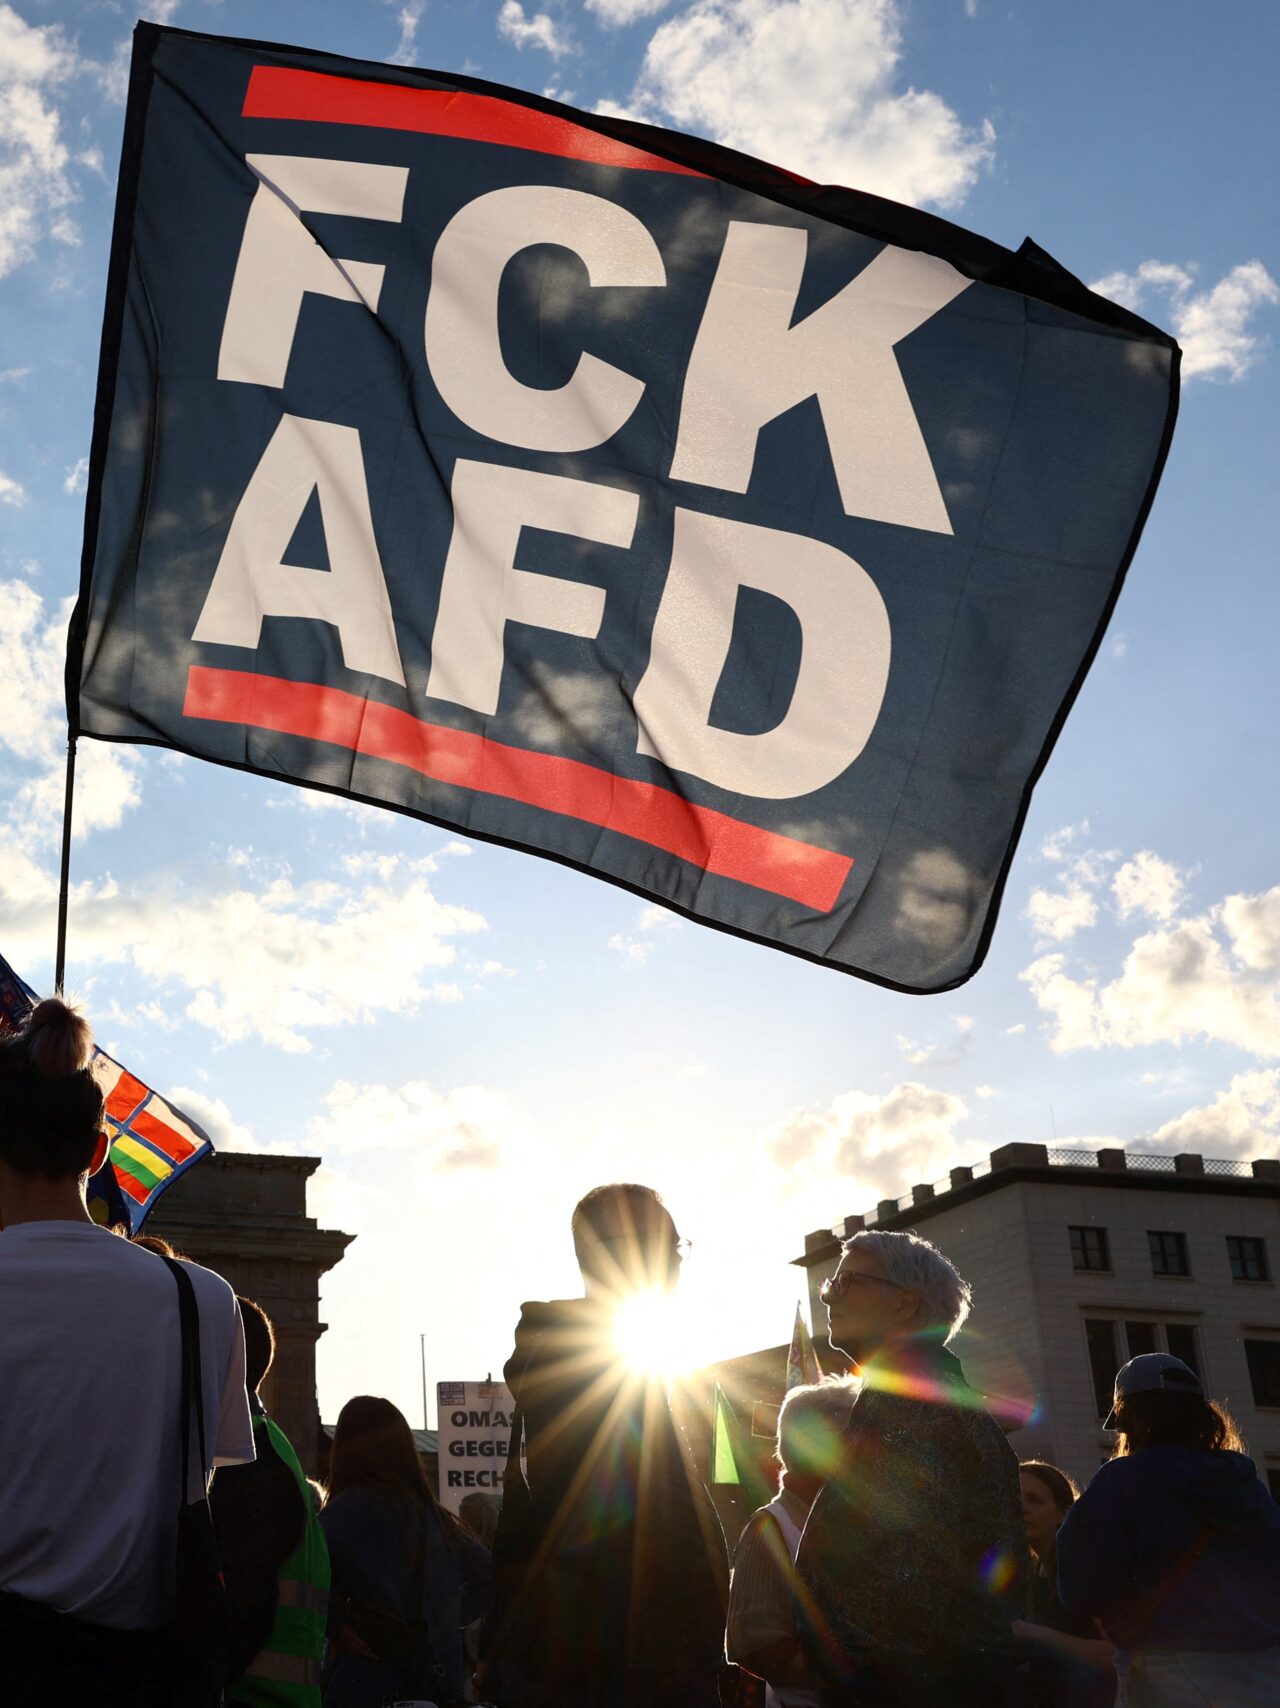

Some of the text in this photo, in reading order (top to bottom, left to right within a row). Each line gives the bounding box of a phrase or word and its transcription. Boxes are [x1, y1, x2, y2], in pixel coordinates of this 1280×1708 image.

[217, 152, 976, 536] FCK
[191, 412, 892, 800] AFD
[447, 1470, 505, 1487] RECH
[448, 1440, 508, 1457] GEGE
